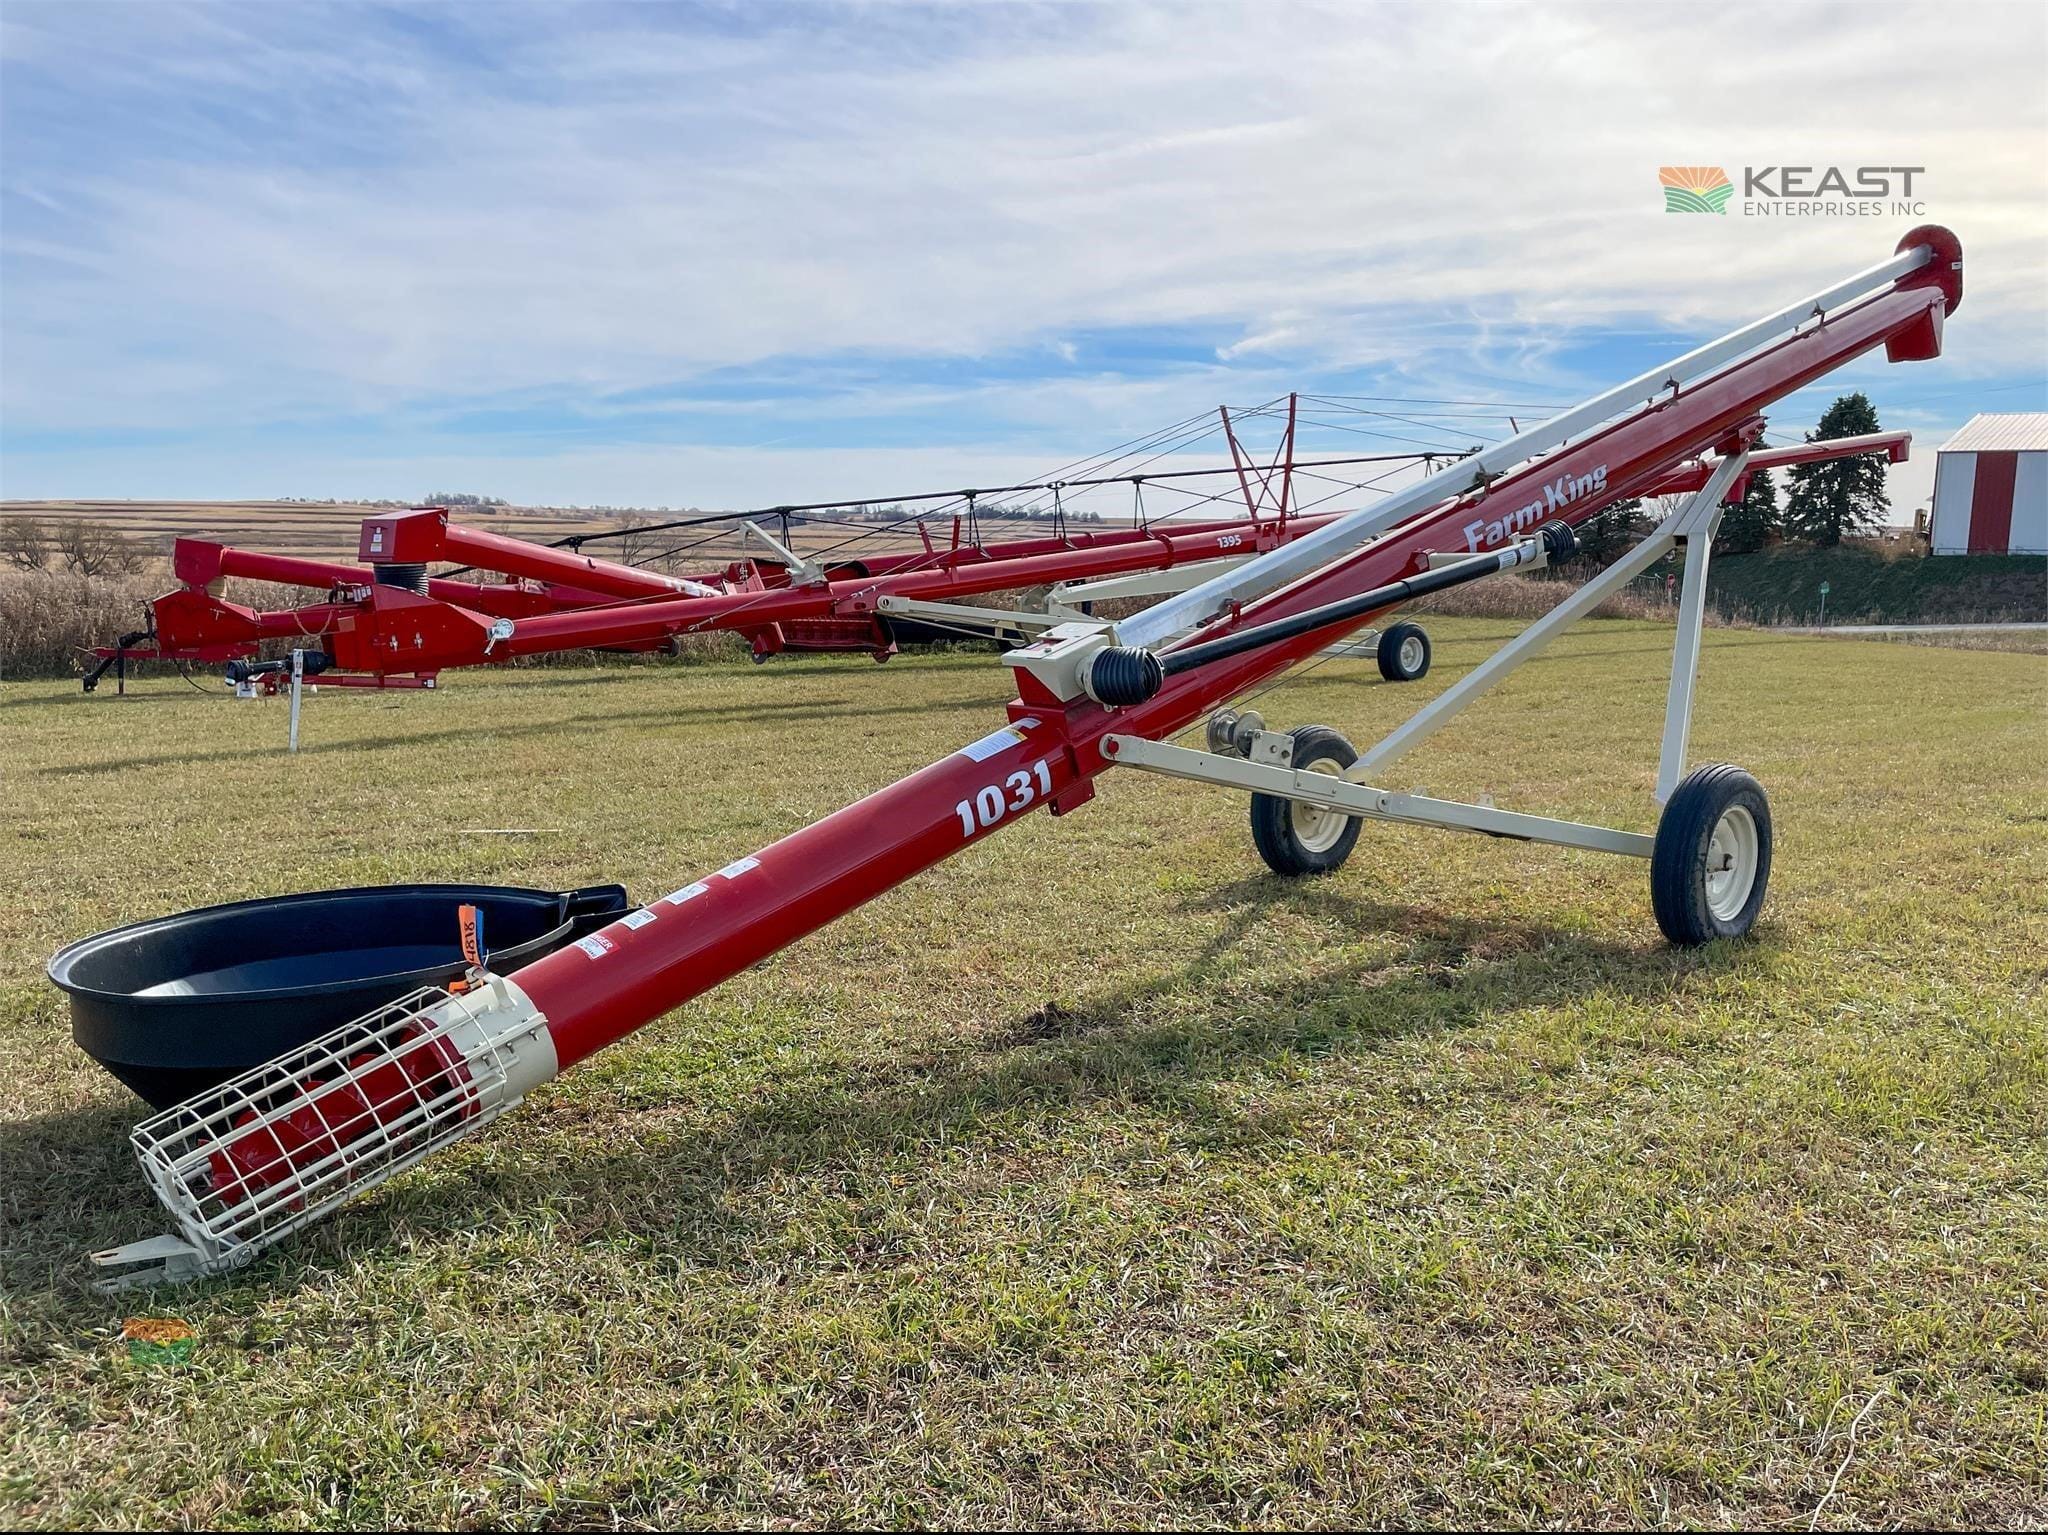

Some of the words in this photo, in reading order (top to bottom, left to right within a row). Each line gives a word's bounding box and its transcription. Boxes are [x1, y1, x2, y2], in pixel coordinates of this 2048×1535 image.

[1216, 534, 1242, 549] 1395
[1463, 499, 1543, 553] Farm
[1543, 464, 1608, 513] King
[956, 758, 1052, 838] 1031
